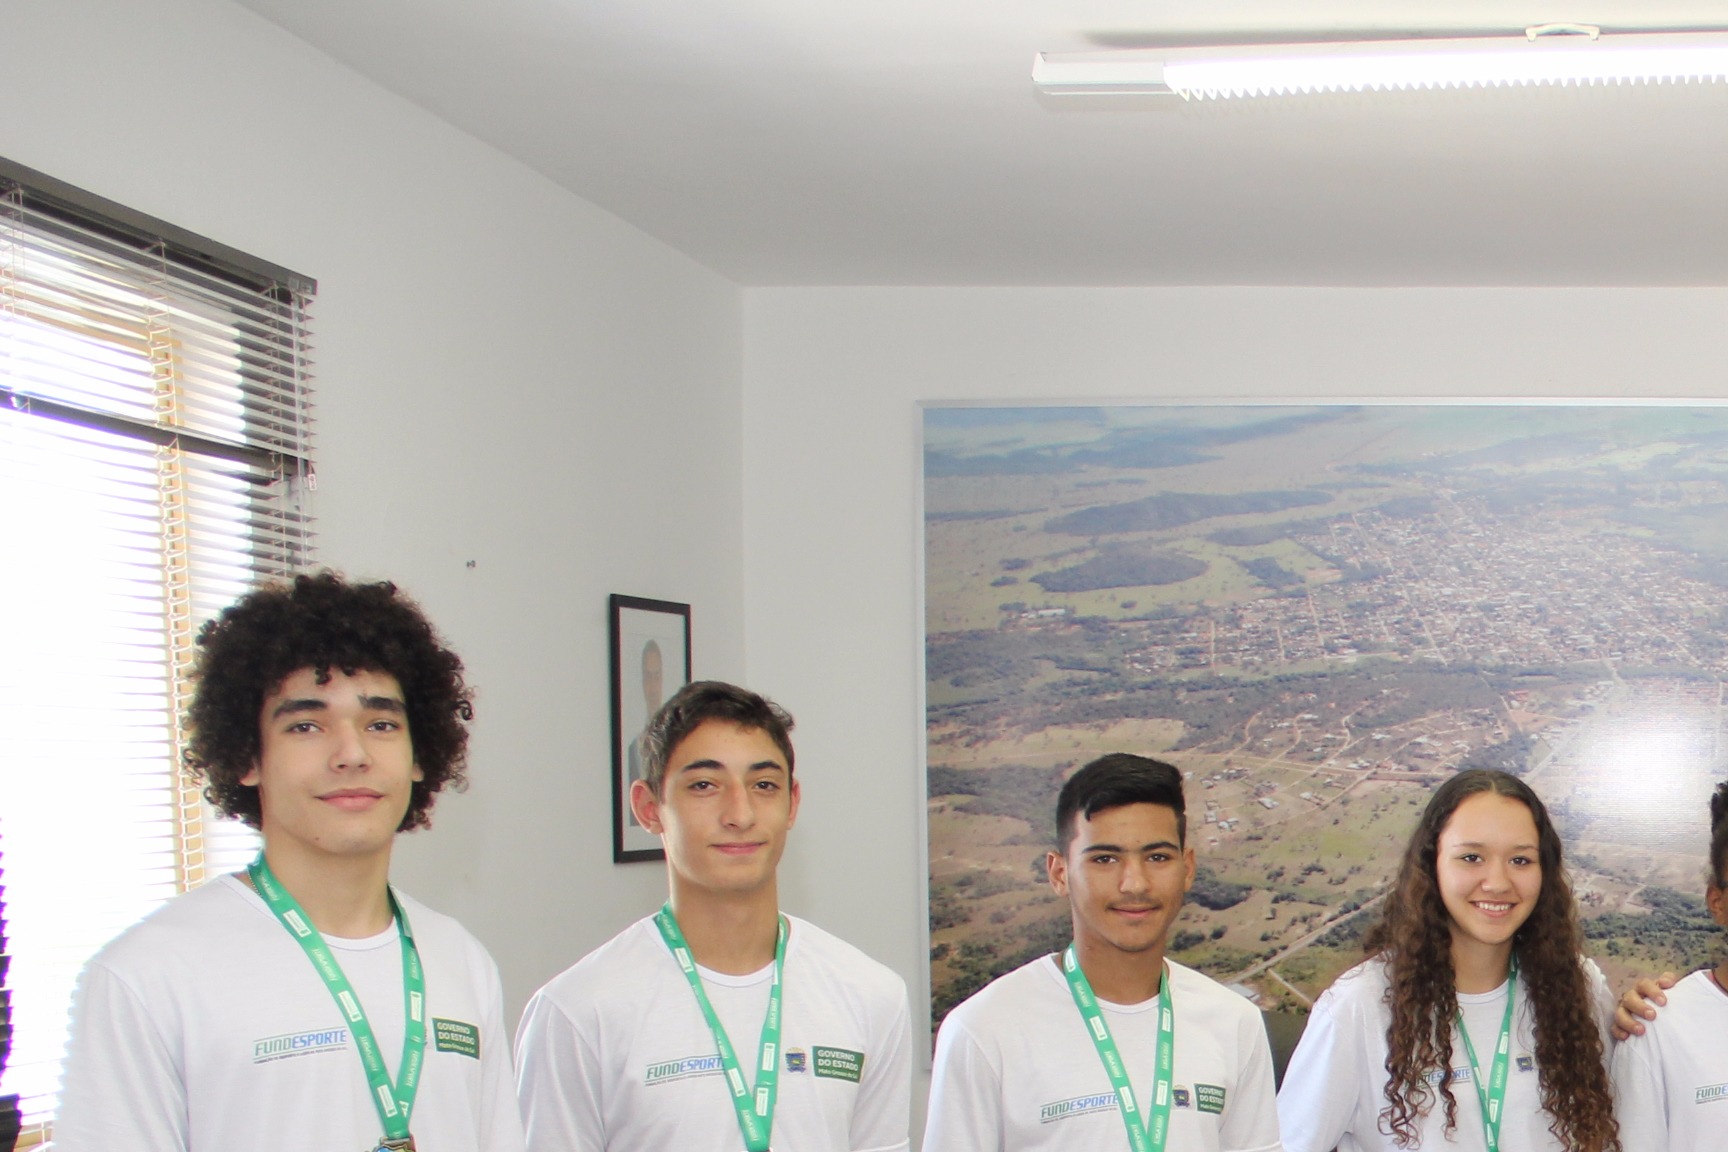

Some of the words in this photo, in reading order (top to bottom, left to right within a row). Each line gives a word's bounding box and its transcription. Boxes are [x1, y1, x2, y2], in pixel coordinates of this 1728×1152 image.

[436, 1021, 470, 1035] GOVERNO
[254, 1029, 347, 1056] FUNDESPORTE
[438, 1031, 450, 1040] DO
[450, 1032, 475, 1046] ESTADO
[817, 1049, 855, 1062] GOVERNO
[818, 1058, 831, 1067] DO
[832, 1059, 859, 1072] ESTADO
